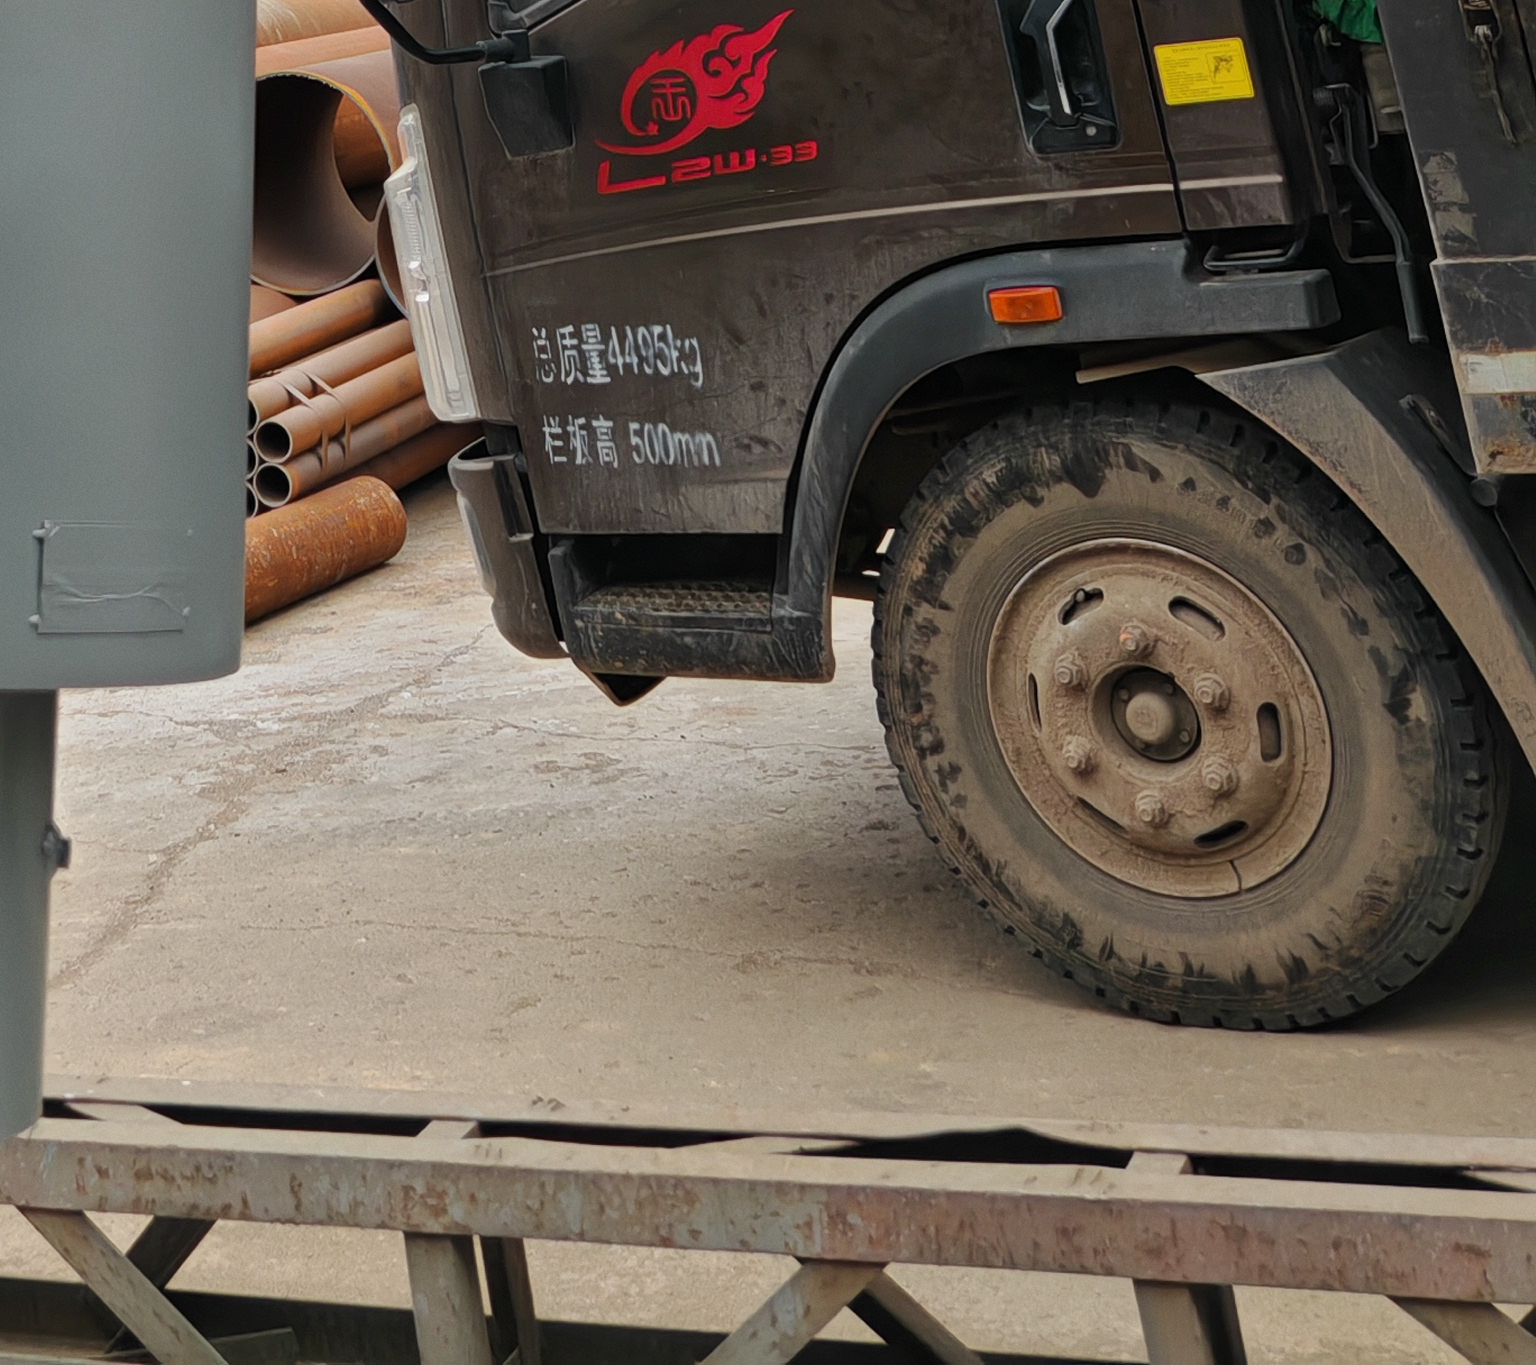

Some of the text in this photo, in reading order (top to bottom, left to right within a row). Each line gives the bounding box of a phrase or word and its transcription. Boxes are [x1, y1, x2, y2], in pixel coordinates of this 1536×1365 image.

[532, 323, 704, 389] 总质量4495kg
[542, 414, 721, 469] 栏板高 500mm
